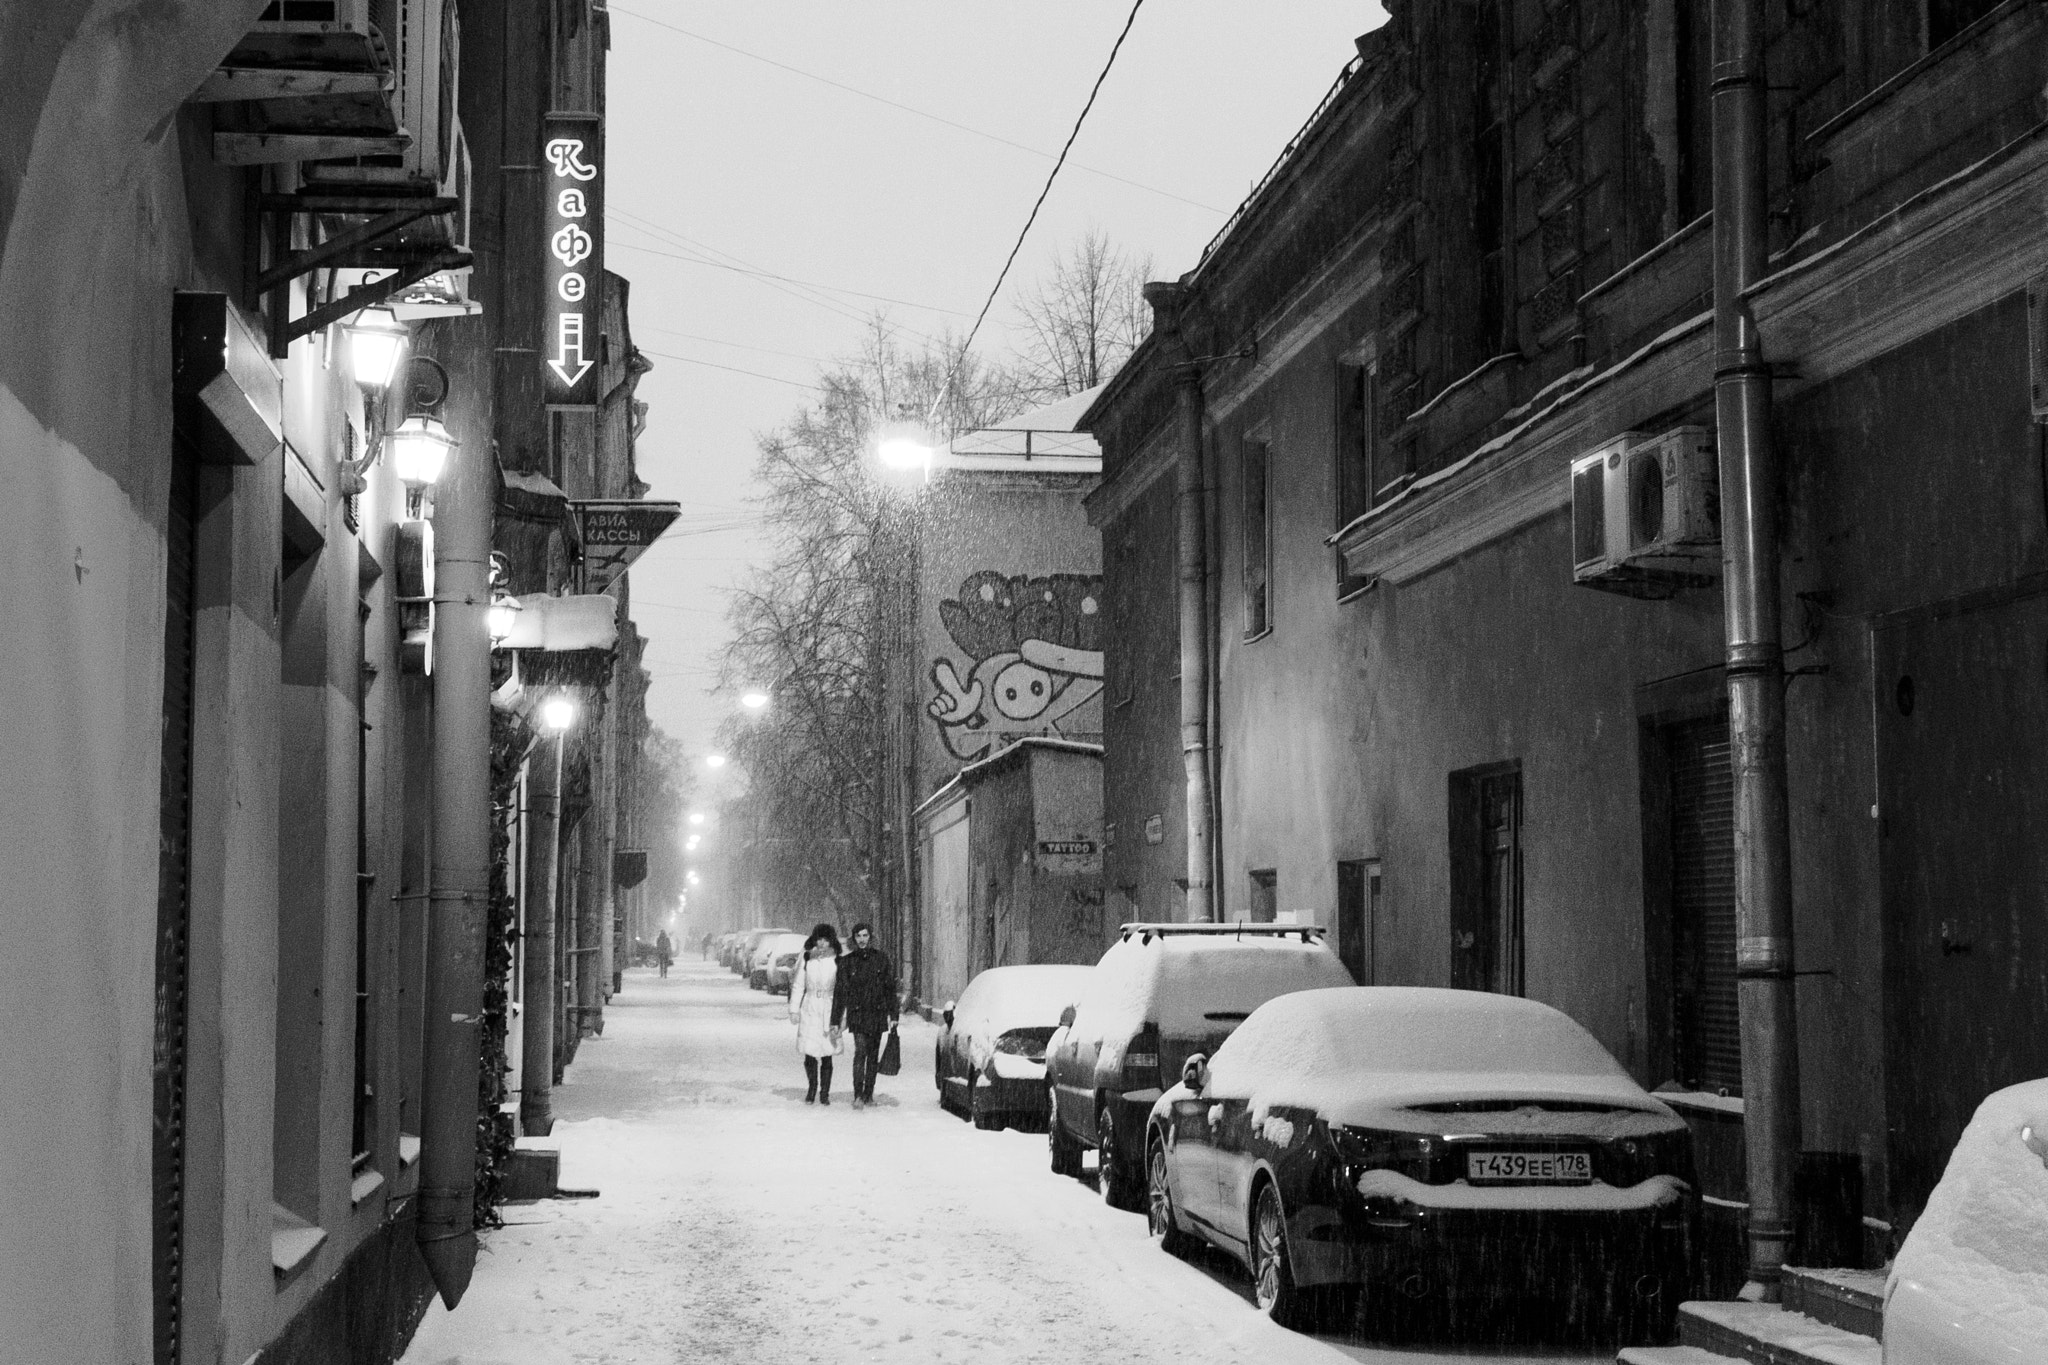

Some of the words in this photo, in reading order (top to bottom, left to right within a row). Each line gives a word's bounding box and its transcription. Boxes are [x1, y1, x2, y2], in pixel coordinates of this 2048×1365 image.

[545, 138, 597, 302] Кафе
[587, 530, 640, 541] КАССЫ
[1047, 842, 1090, 853] TATTOO
[1556, 1155, 1585, 1171] 178
